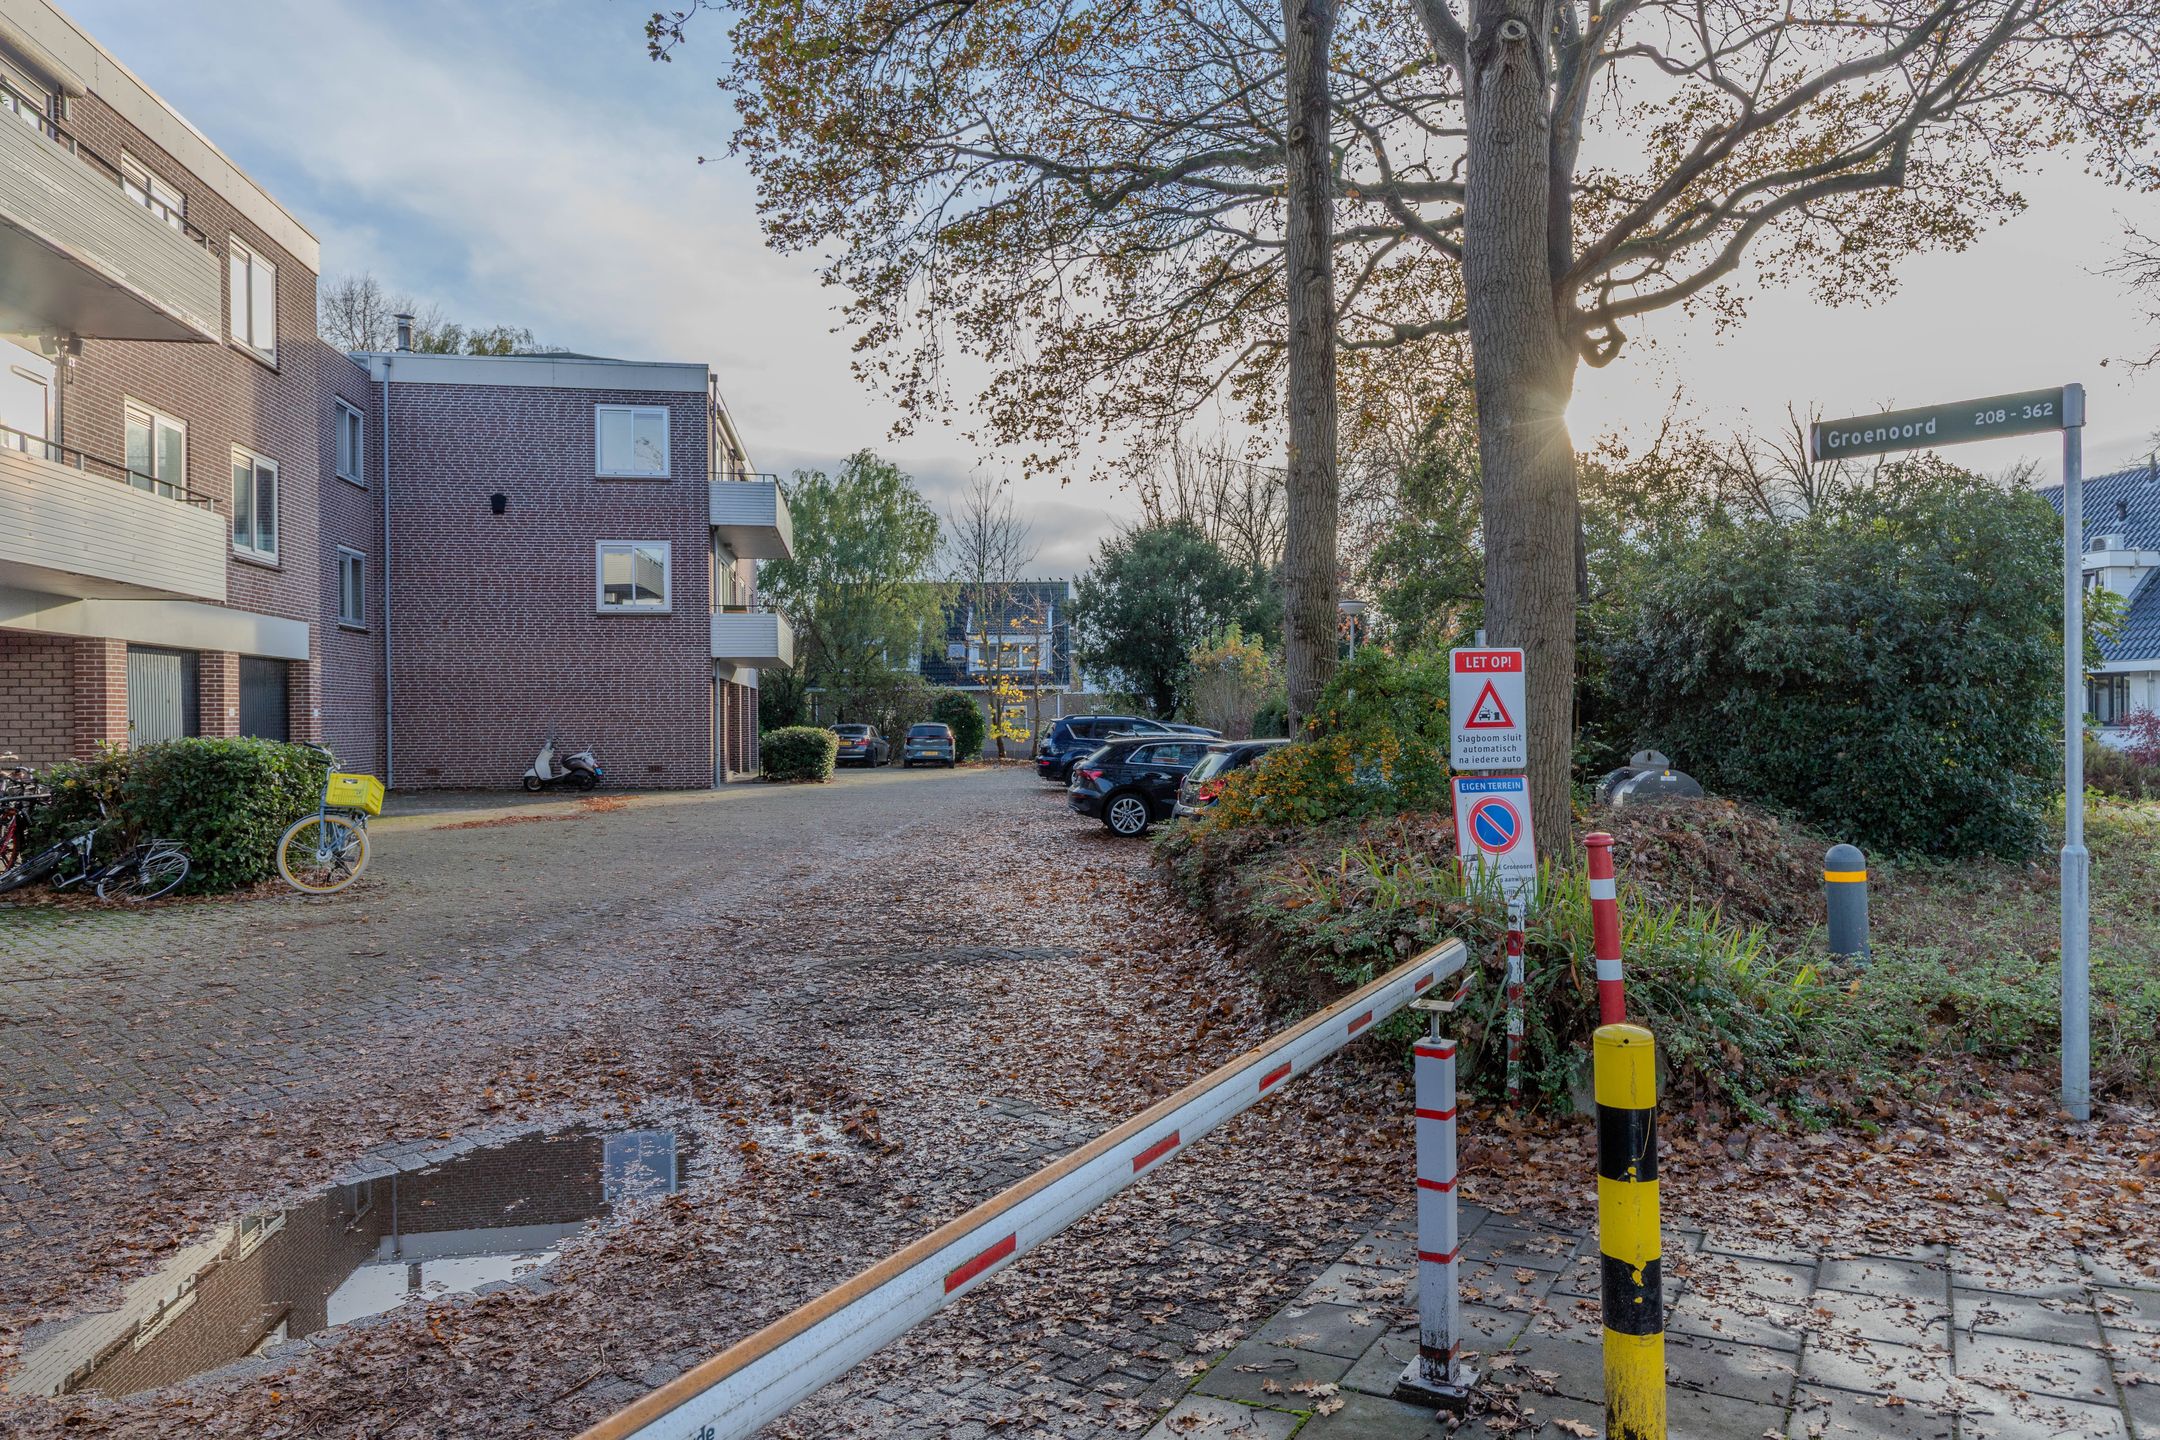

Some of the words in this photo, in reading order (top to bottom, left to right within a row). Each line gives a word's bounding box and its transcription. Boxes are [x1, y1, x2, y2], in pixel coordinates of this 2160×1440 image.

[1828, 417, 1936, 448] Groenoord
[1975, 409, 2006, 426] 208
[2022, 402, 2053, 420] 362
[1466, 656, 1487, 668] LET
[1491, 656, 1511, 668] OP!
[1457, 734, 1499, 744] Slagboom
[1503, 734, 1522, 742] sluit
[1463, 745, 1516, 753] automatisch
[1461, 783, 1486, 791] EIGEN
[1487, 782, 1521, 790] TERREIN
